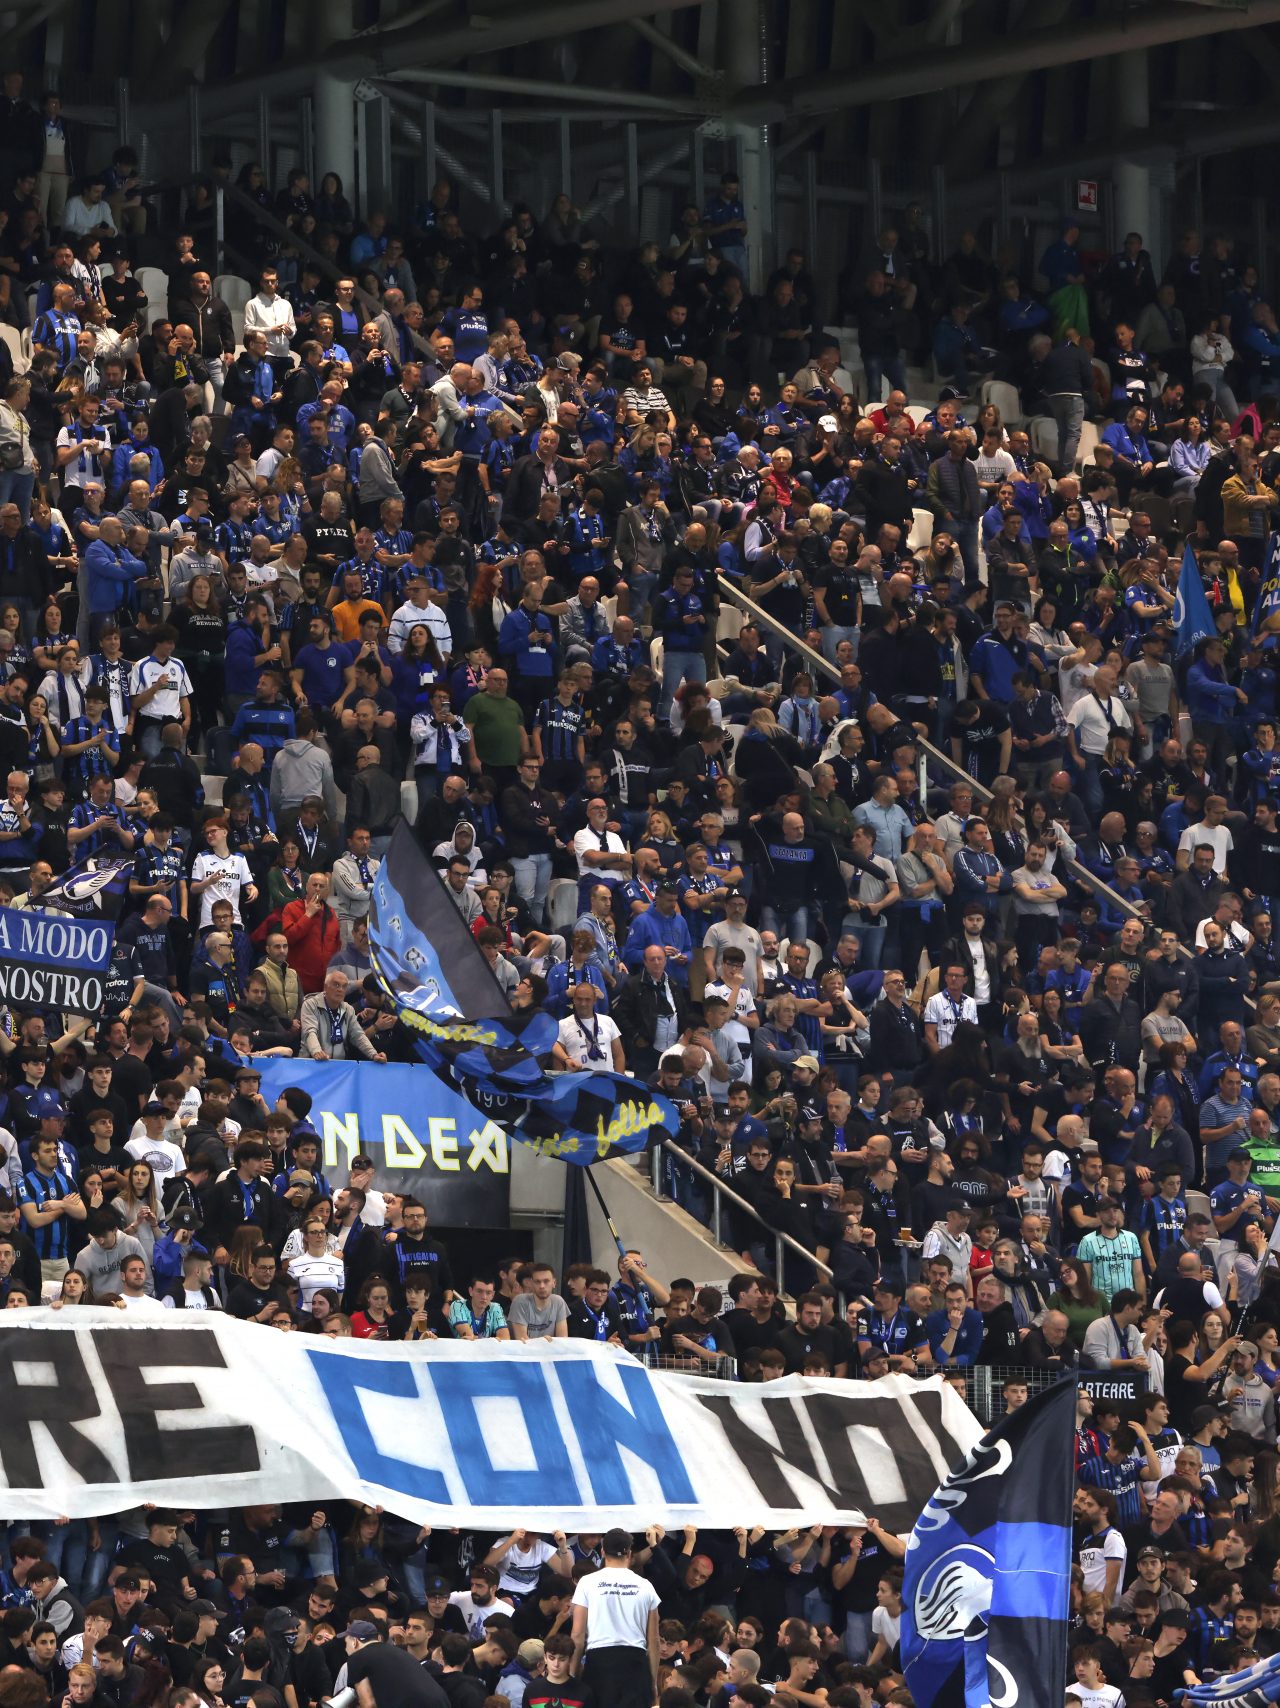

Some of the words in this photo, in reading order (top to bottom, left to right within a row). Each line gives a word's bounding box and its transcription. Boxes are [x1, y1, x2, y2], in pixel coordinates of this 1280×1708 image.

[21, 918, 108, 962] MODO
[106, 979, 129, 988] ratour
[1076, 1381, 1135, 1399] ARTERRE
[306, 1349, 698, 1506] CON
